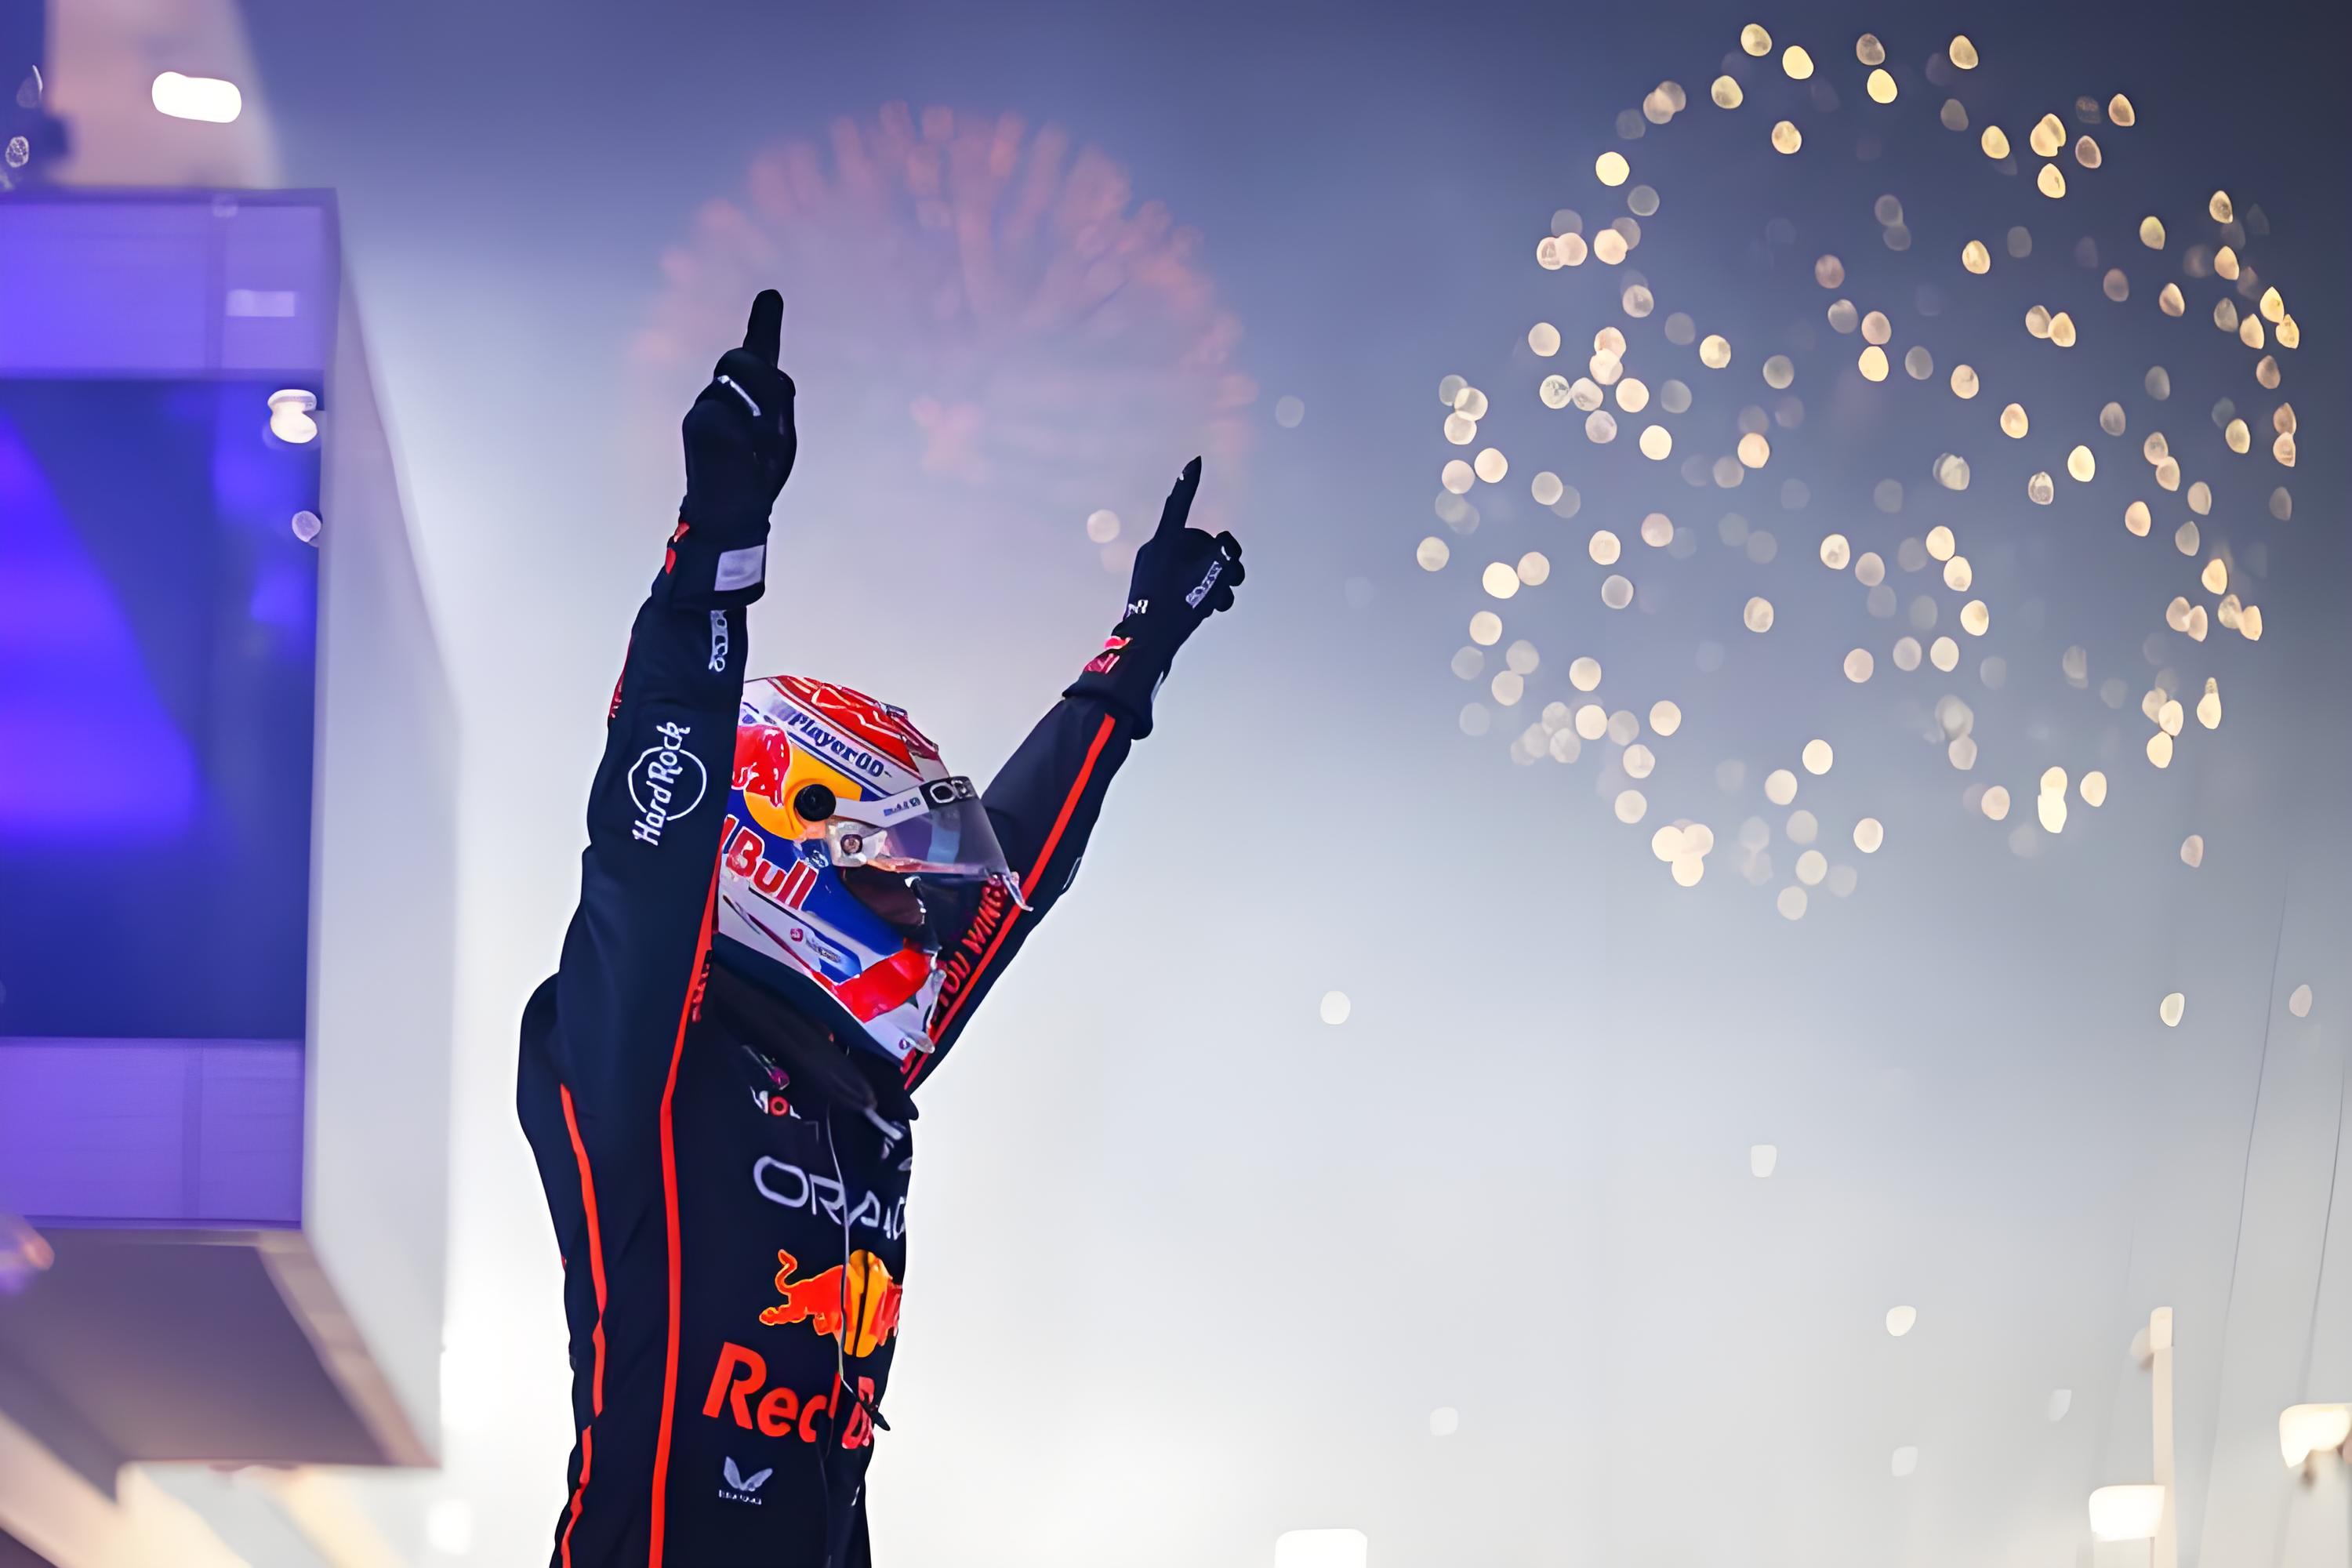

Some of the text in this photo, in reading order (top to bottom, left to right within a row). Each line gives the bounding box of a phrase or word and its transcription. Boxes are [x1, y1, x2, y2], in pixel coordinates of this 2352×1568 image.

[632, 720, 691, 847] Hard Rock
[726, 826, 818, 911] Bull
